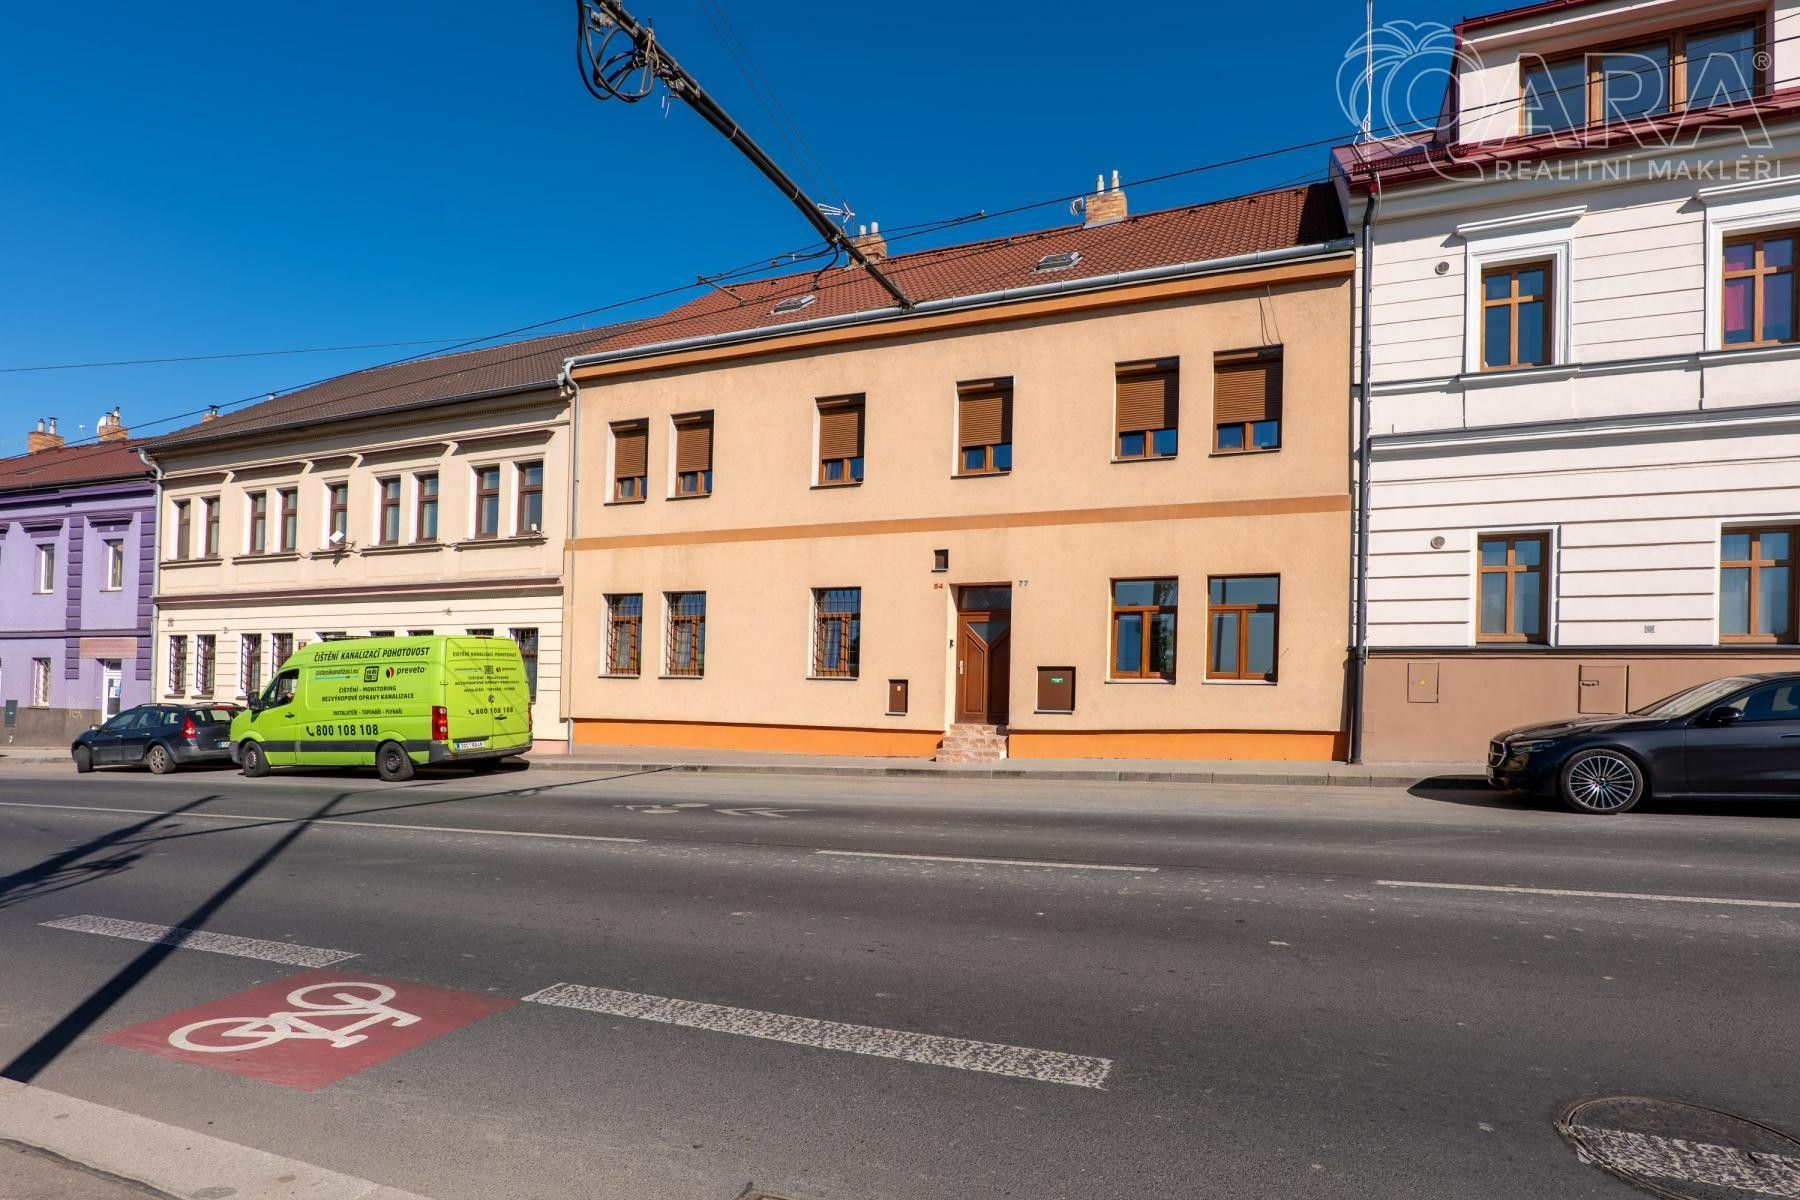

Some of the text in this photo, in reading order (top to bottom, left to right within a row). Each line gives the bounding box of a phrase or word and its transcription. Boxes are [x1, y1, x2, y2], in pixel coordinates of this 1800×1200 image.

[314, 647, 430, 662] ČIŠTĚNÍ KANALIZACÍ POHOTOVOST
[396, 666, 425, 675] preveto
[316, 724, 379, 736] 800 108 108
